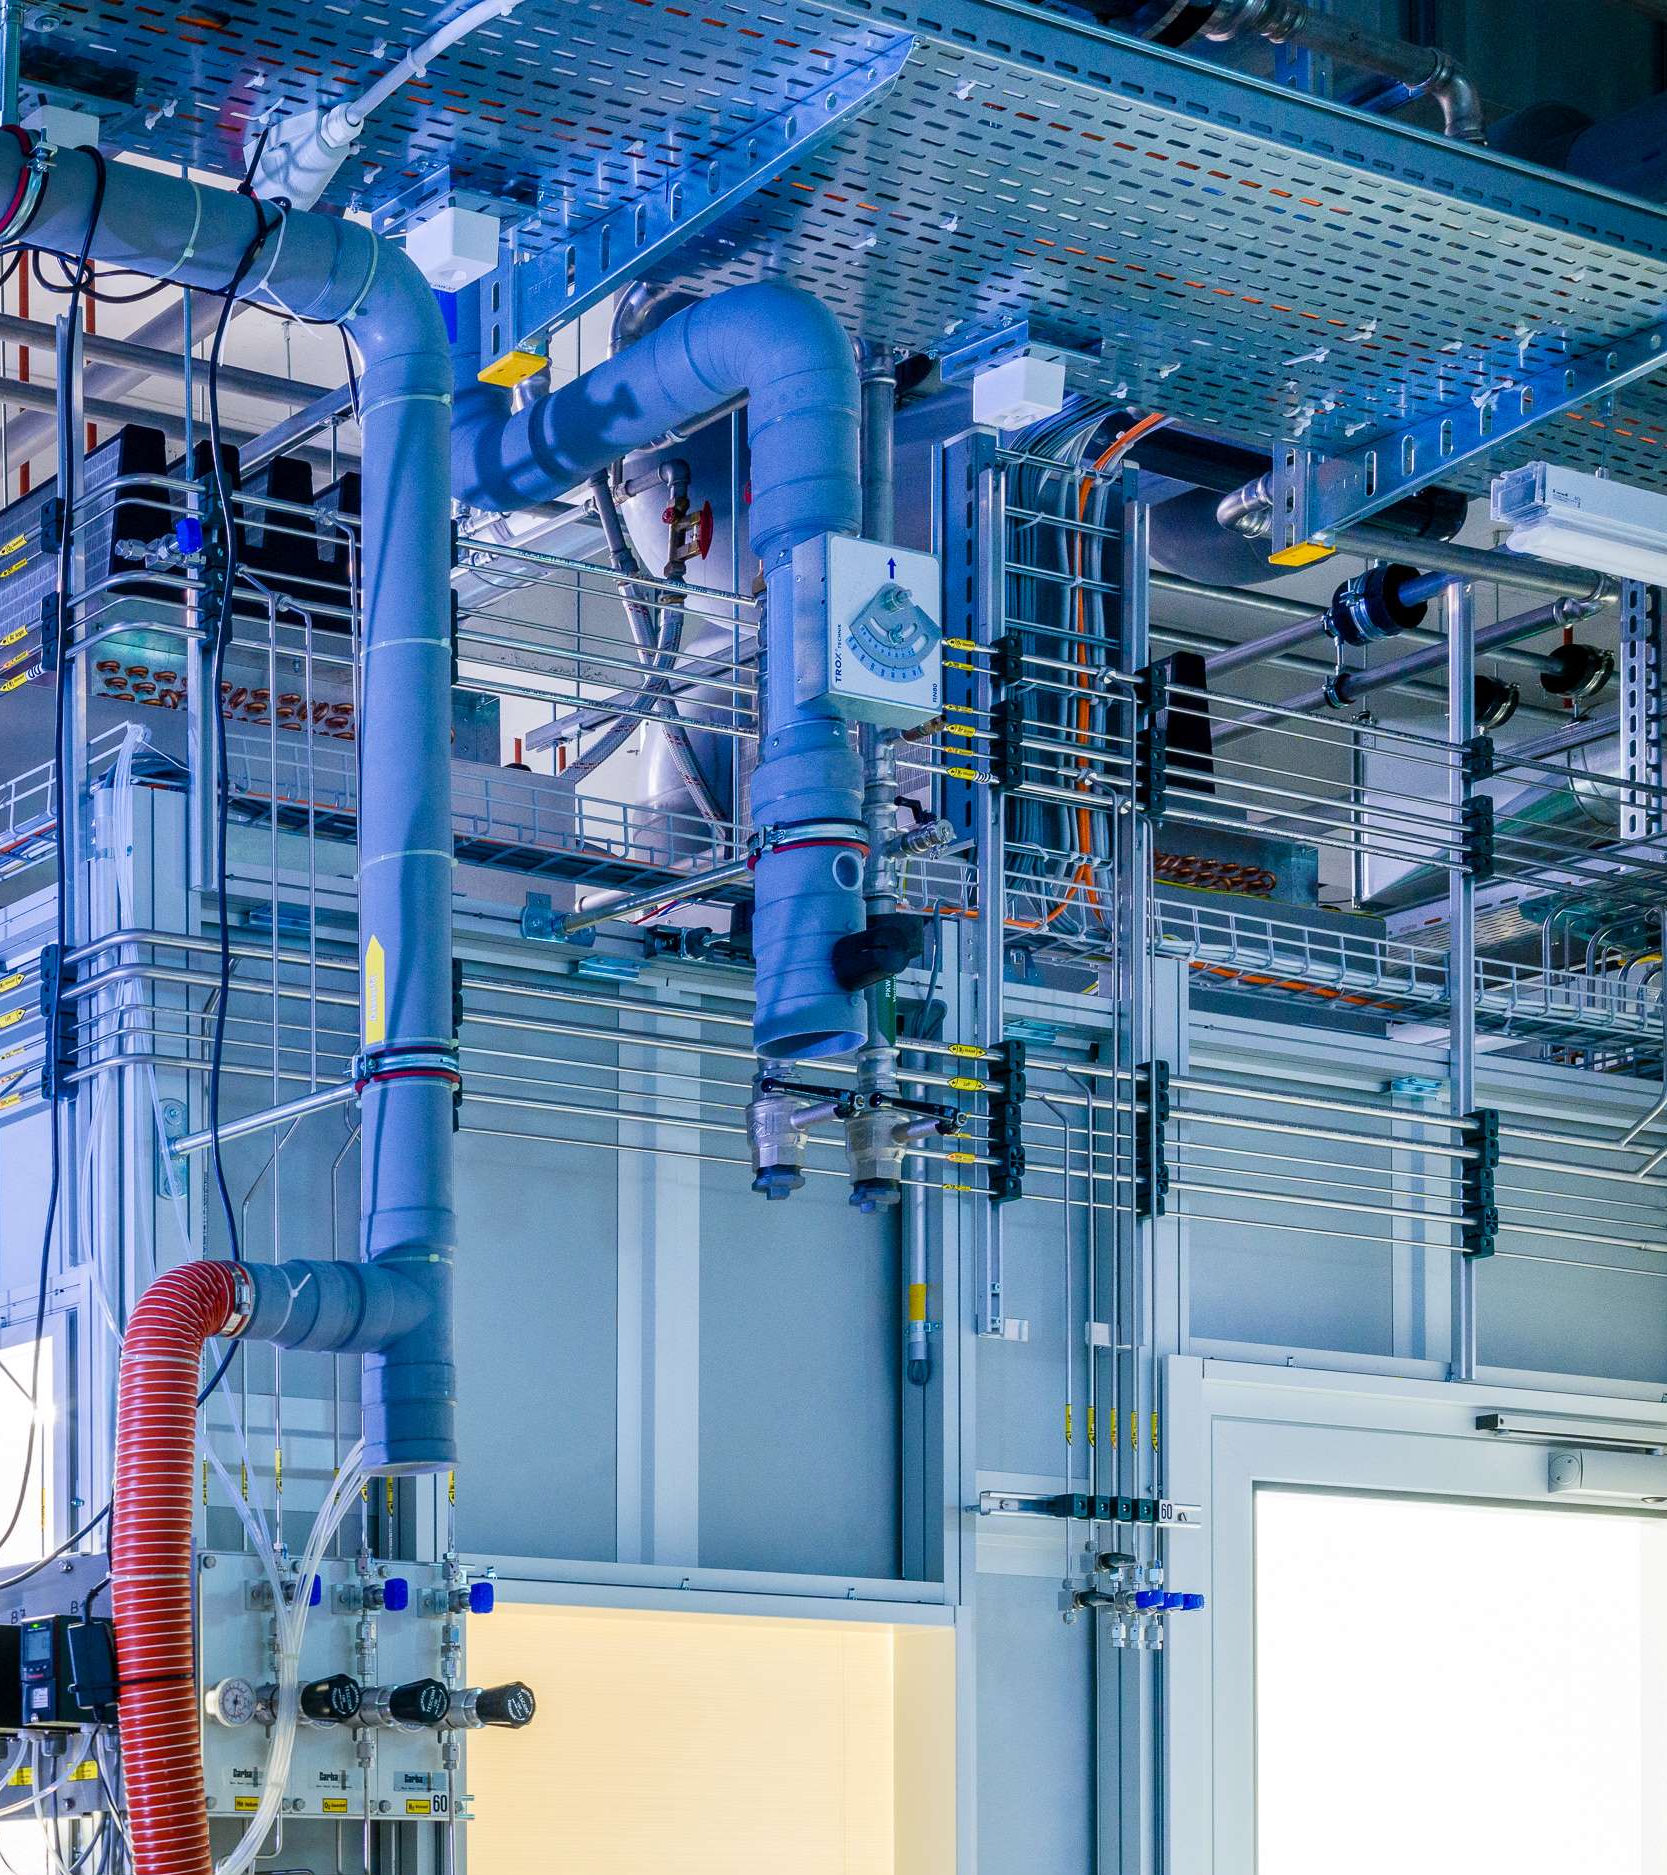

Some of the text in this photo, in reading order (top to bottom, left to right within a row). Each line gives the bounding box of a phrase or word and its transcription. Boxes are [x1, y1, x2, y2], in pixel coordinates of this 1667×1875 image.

[834, 651, 842, 683] TROX
[1161, 1503, 1172, 1520] 60
[433, 1795, 447, 1812] 60
